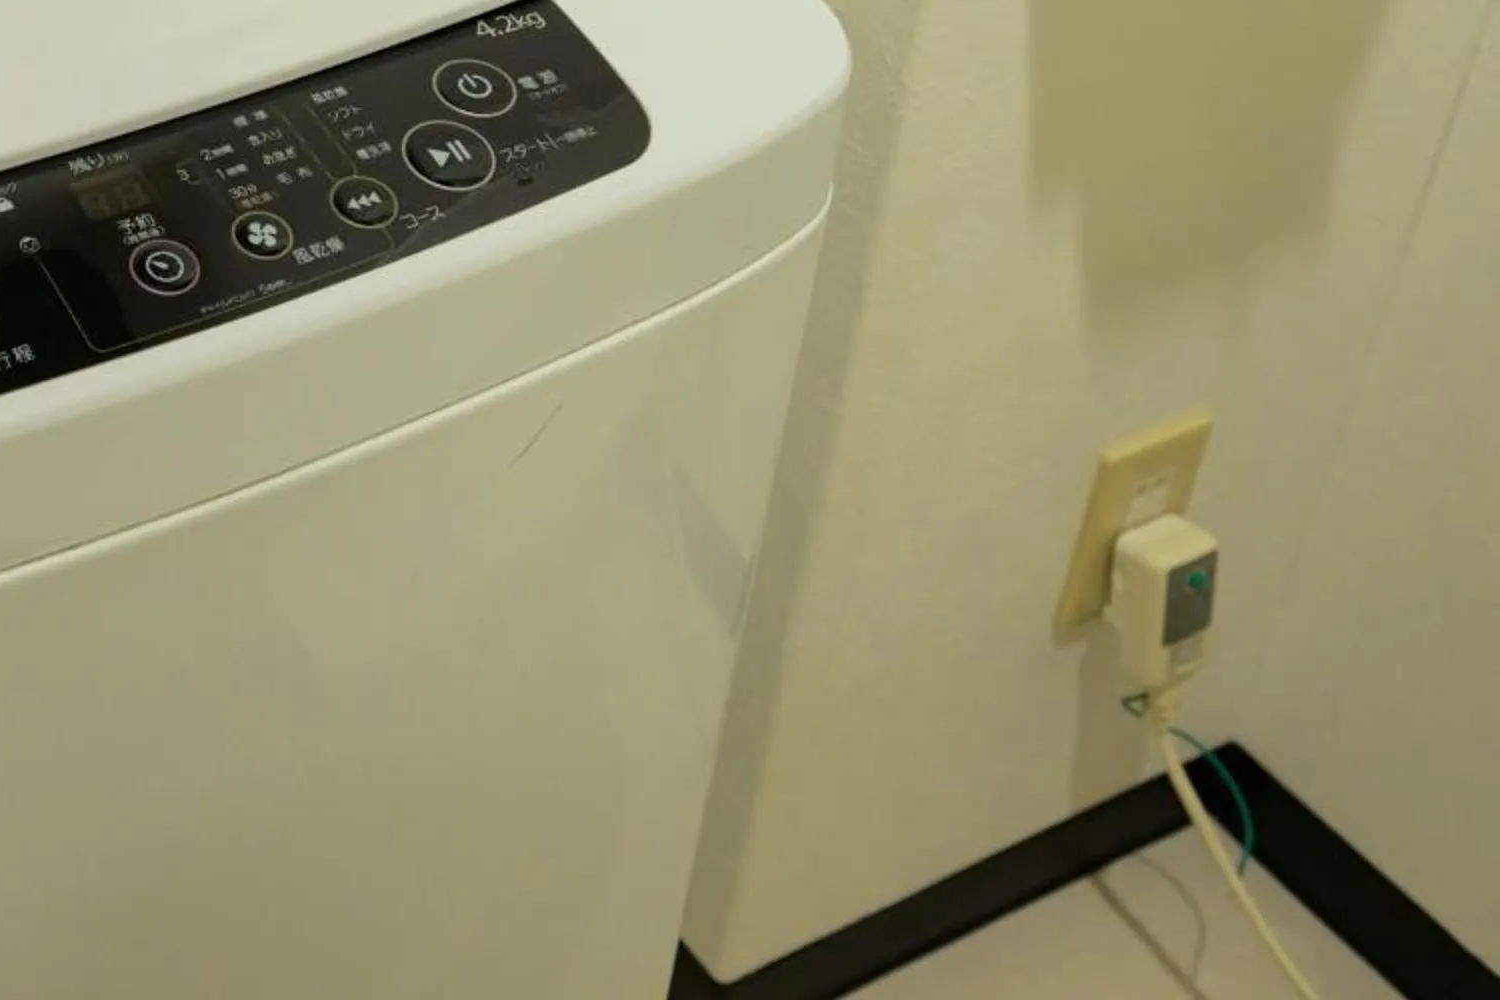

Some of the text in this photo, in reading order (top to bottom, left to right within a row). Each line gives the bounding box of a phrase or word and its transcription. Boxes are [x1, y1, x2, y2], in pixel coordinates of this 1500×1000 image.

[476, 10, 548, 38] 4.2kg
[400, 204, 446, 230] コース
